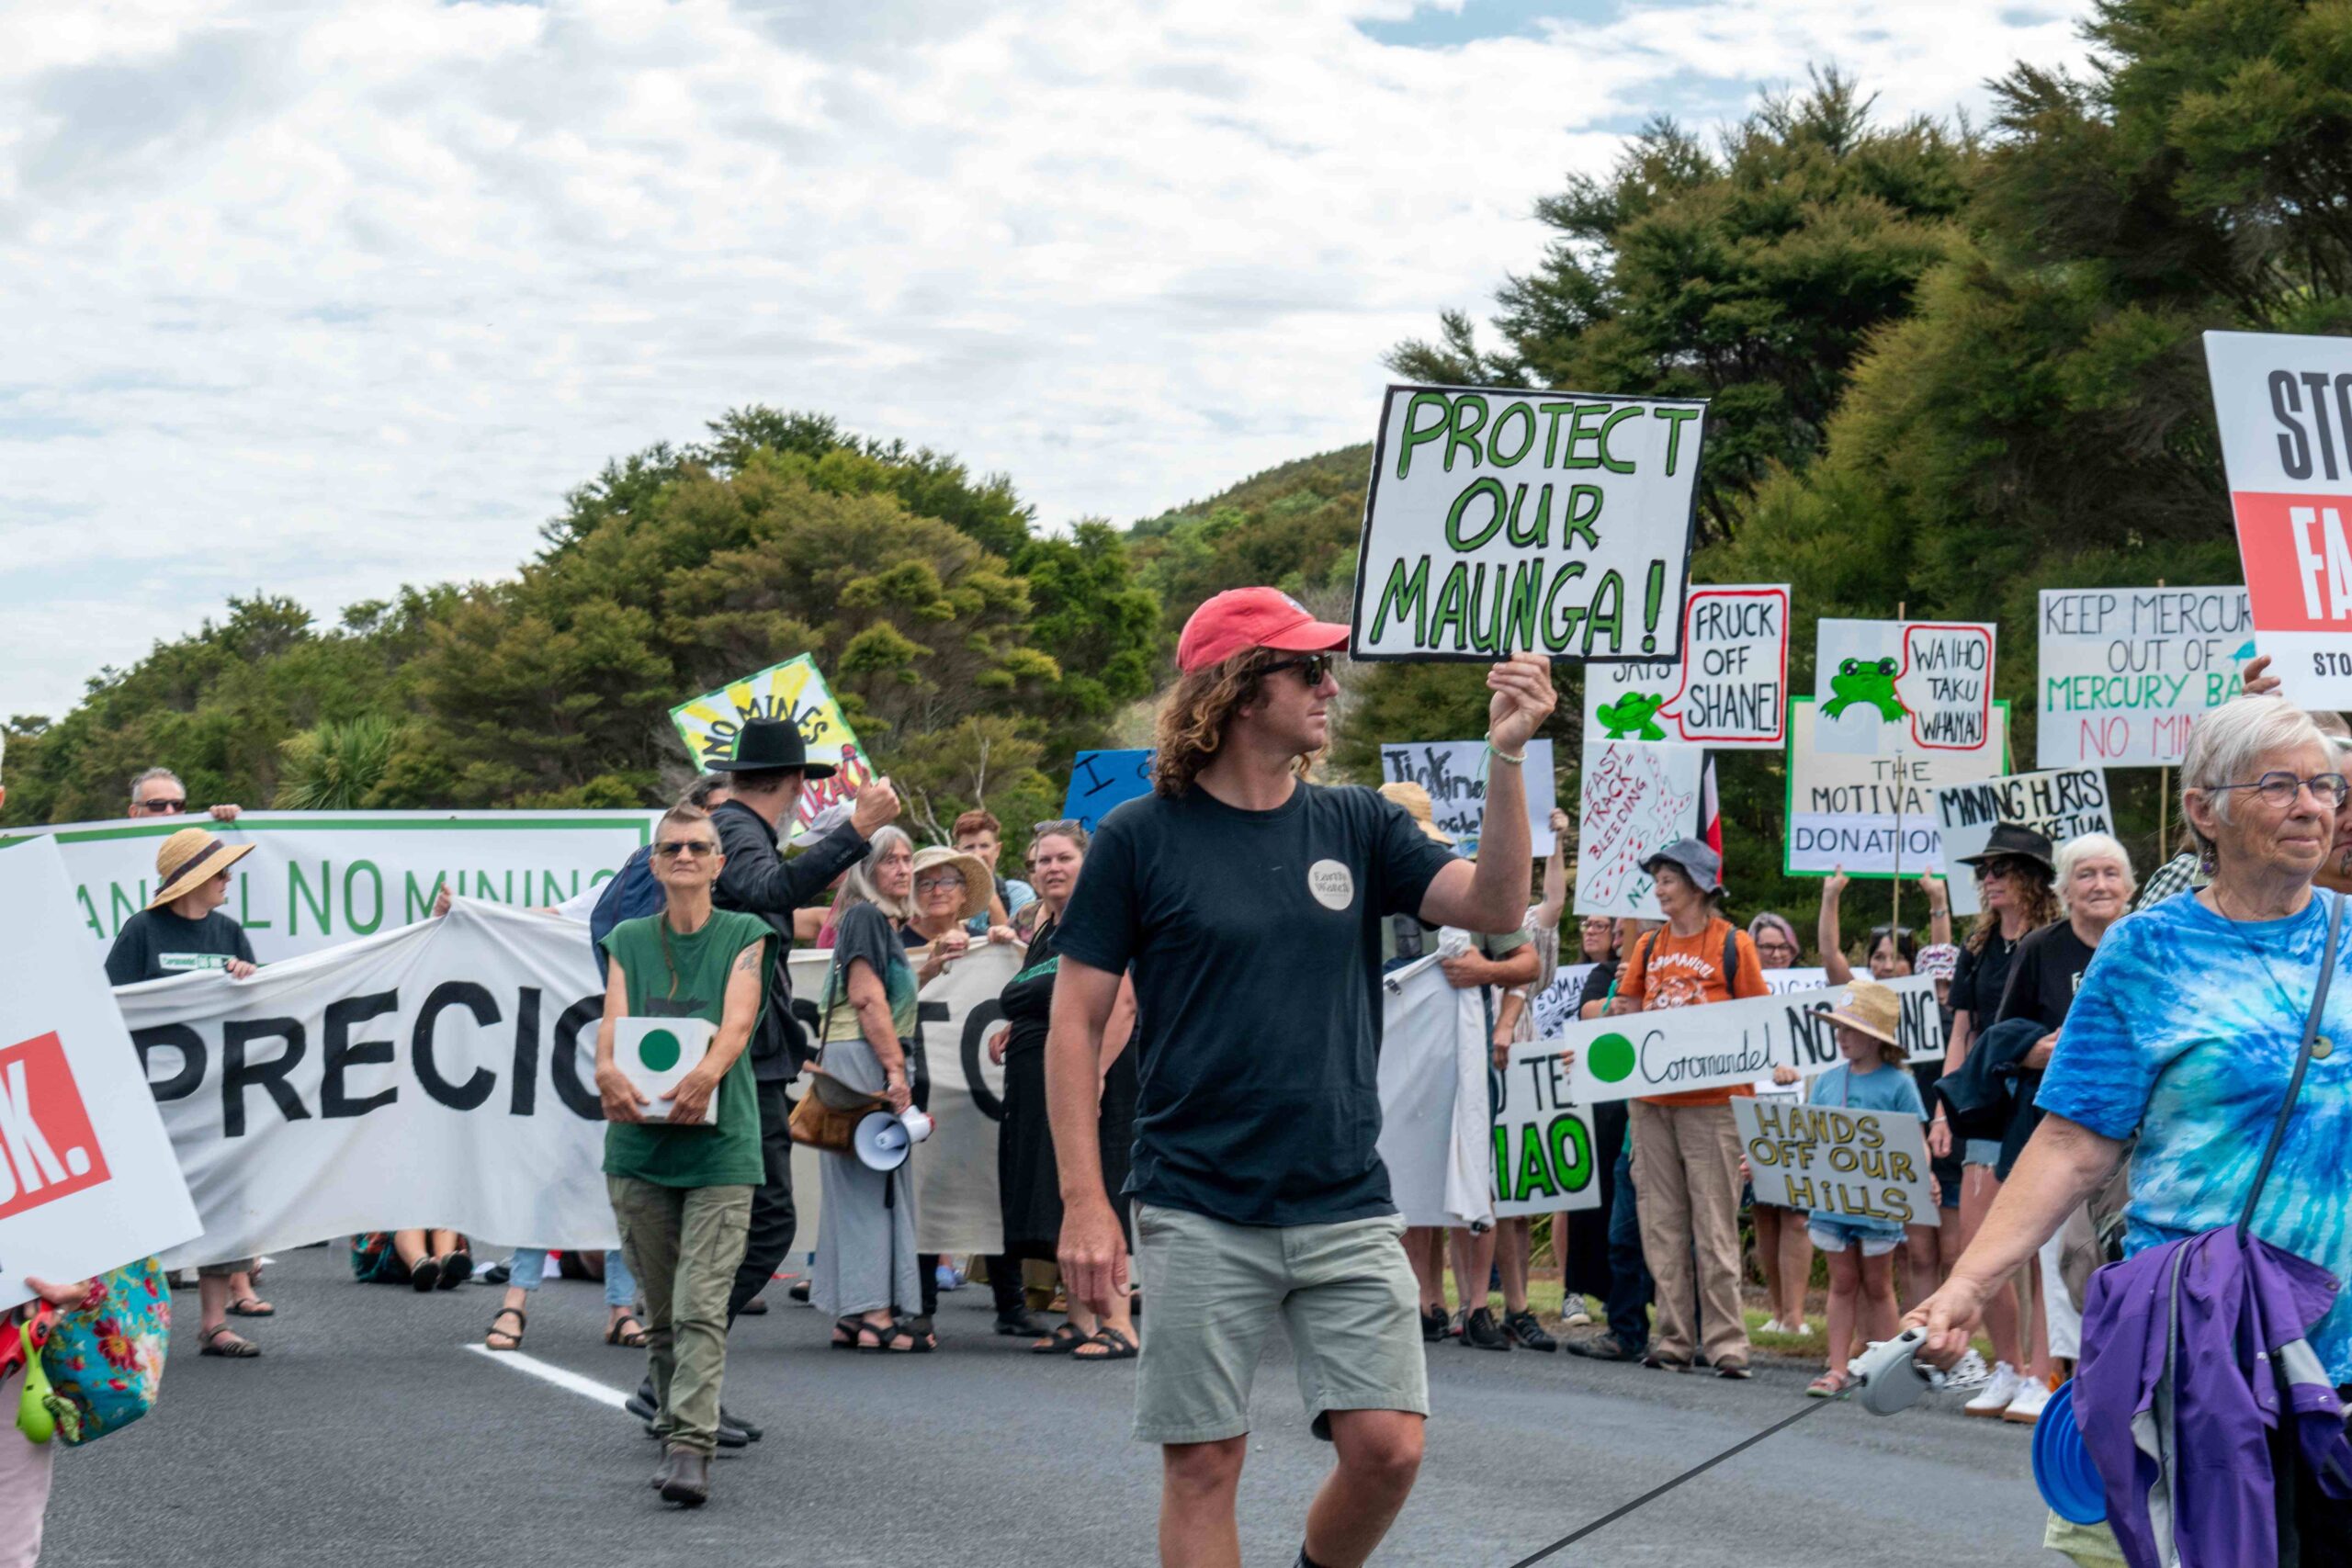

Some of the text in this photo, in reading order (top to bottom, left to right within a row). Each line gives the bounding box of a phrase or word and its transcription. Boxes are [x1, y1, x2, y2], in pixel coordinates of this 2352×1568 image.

[1396, 391, 1700, 479] PROTECT
[1445, 477, 1604, 552] OUR
[1369, 554, 1666, 655] MAUNGA!
[1696, 602, 1775, 641] FRUCK
[2045, 594, 2117, 635] KEEP
[1703, 646, 1751, 676] OFF
[1911, 637, 1985, 671] WAIHO
[2108, 638, 2222, 673] OUT OF
[1688, 682, 1779, 732] SHANE!
[1927, 677, 1979, 702] TAKU
[2047, 672, 2190, 712] MERCURY
[703, 695, 829, 761] NO MINES
[2080, 716, 2130, 760] NO
[1584, 742, 1621, 806] FAST
[1871, 761, 1932, 781] THE
[1583, 765, 1633, 830] TRACK
[1588, 776, 1648, 861] BLEEDING
[1811, 784, 1932, 815] MOTIVA
[1939, 770, 2104, 828] MINING HURTS
[288, 859, 383, 936] NO
[1786, 1000, 1838, 1066] NO
[1519, 1053, 1577, 1111] TE
[1755, 1103, 1885, 1148] HANDS
[1748, 1137, 1917, 1183] OFF OUR
